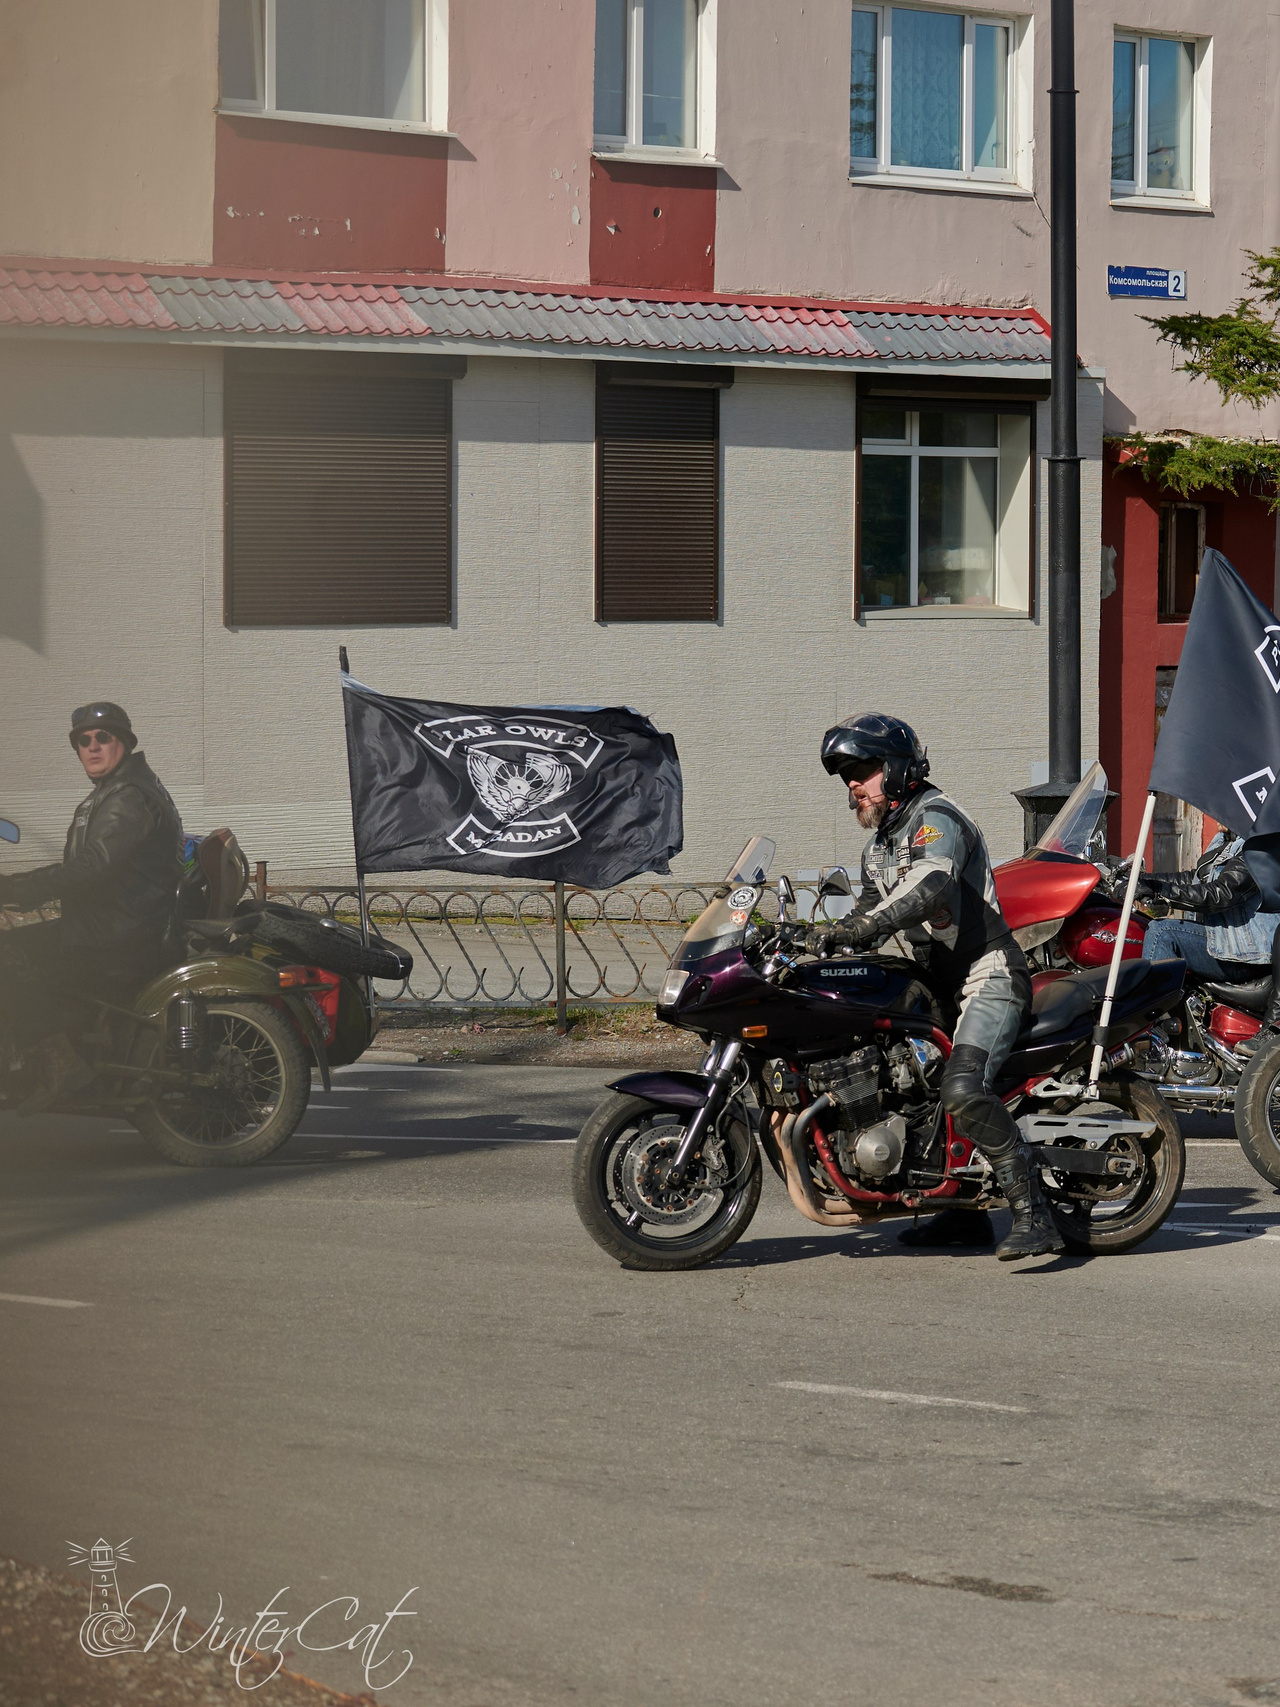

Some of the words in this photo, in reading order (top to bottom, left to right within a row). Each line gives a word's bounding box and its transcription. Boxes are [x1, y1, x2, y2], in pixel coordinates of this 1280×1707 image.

[1109, 274, 1167, 287] Комсомольская
[1173, 275, 1180, 292] 2
[505, 725, 588, 748] OWLS
[820, 968, 867, 977] SUZUKI
